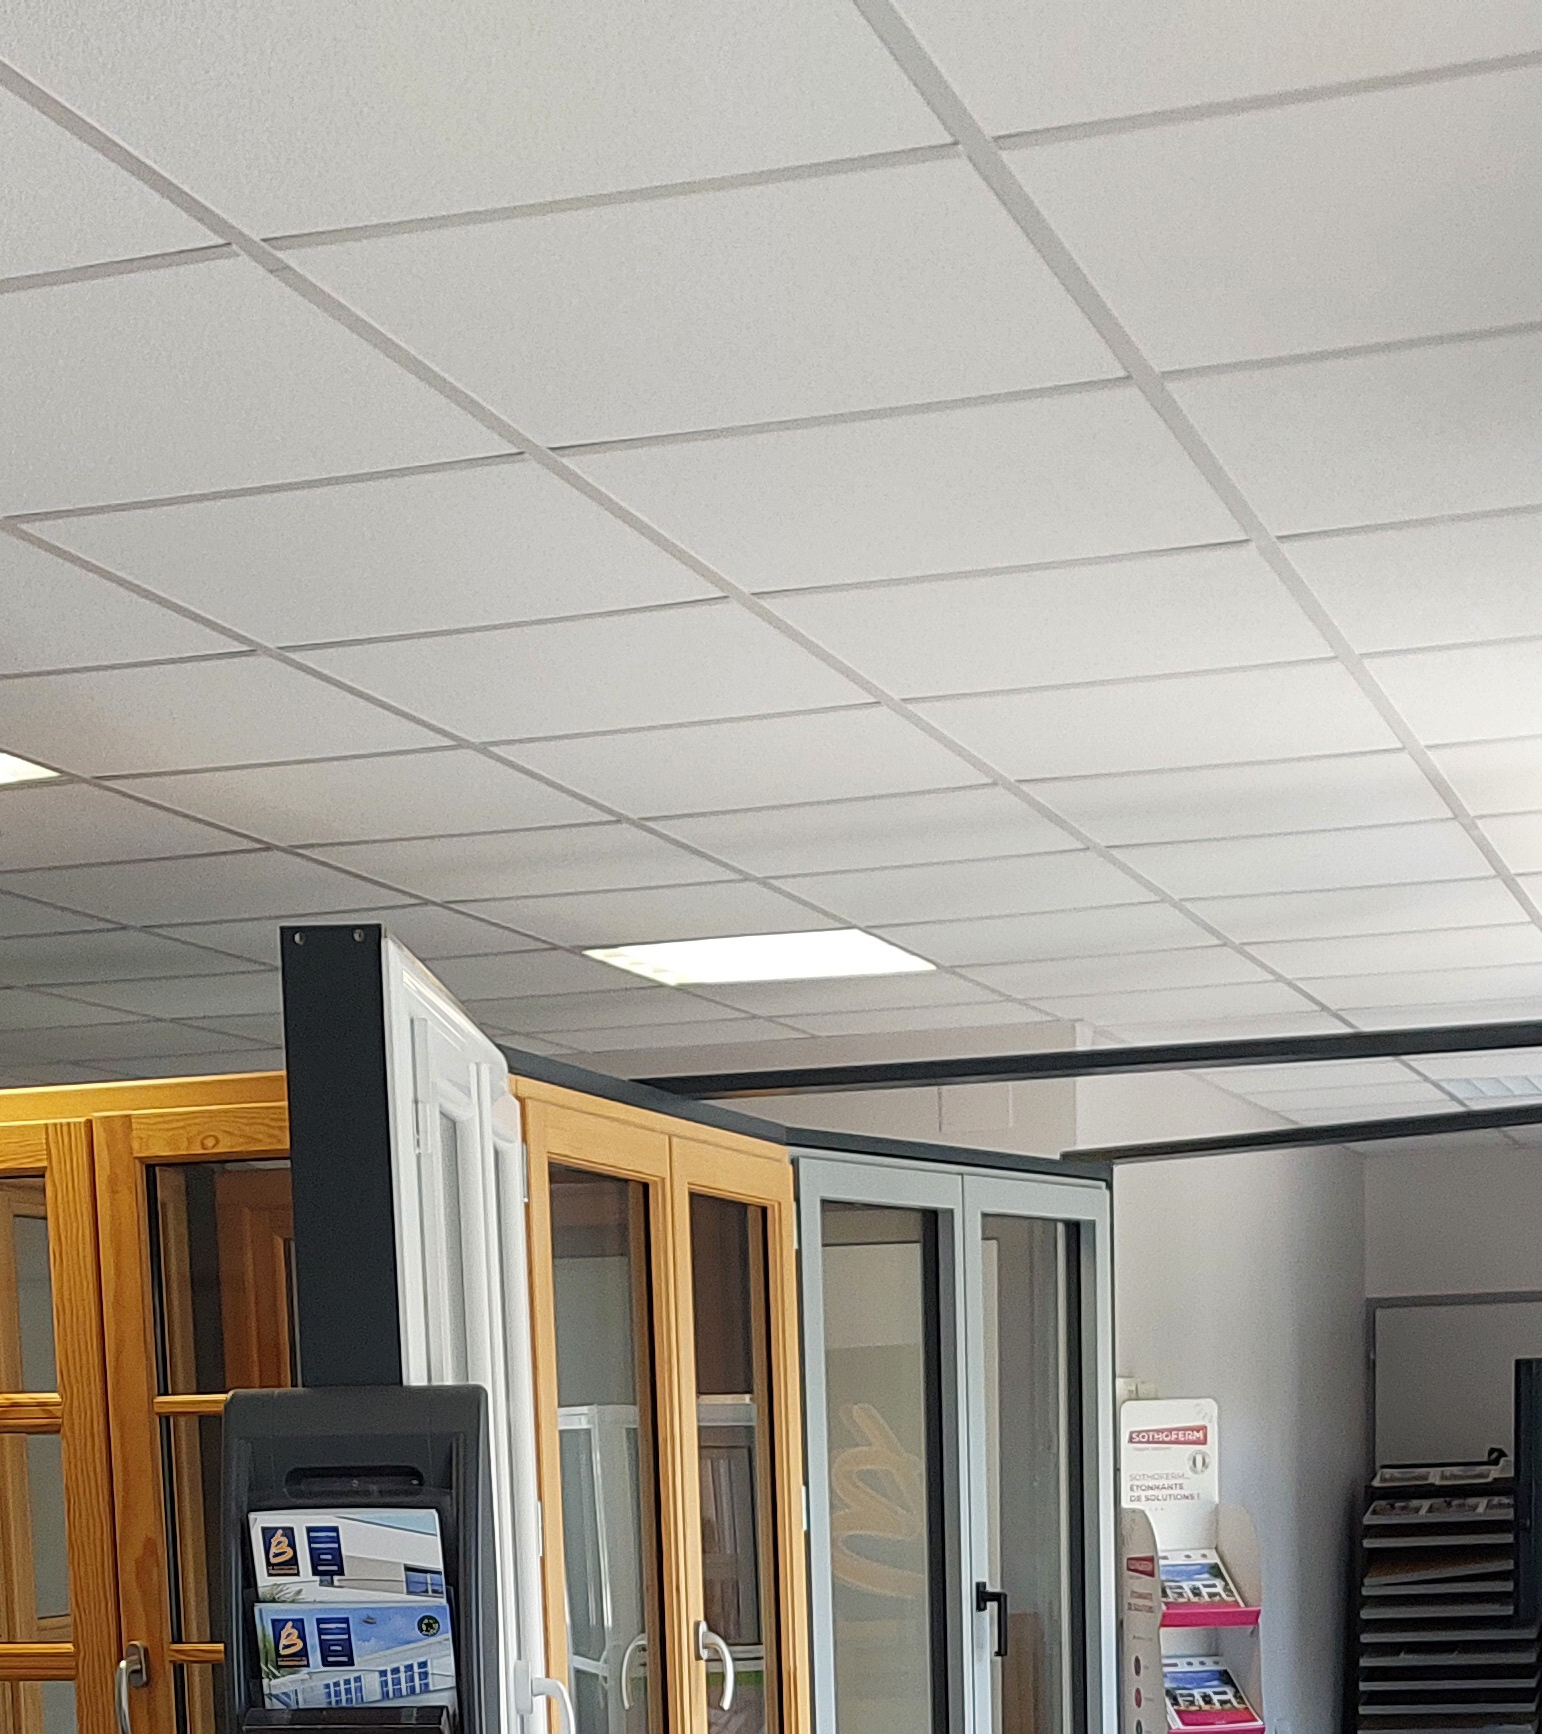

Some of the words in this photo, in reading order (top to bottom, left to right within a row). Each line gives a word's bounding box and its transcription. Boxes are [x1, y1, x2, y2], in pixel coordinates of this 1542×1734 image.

[1131, 1430, 1204, 1442] SOTHOFERM
[1129, 1494, 1141, 1502] DE
[1144, 1492, 1195, 1502] SOLUTIONS
